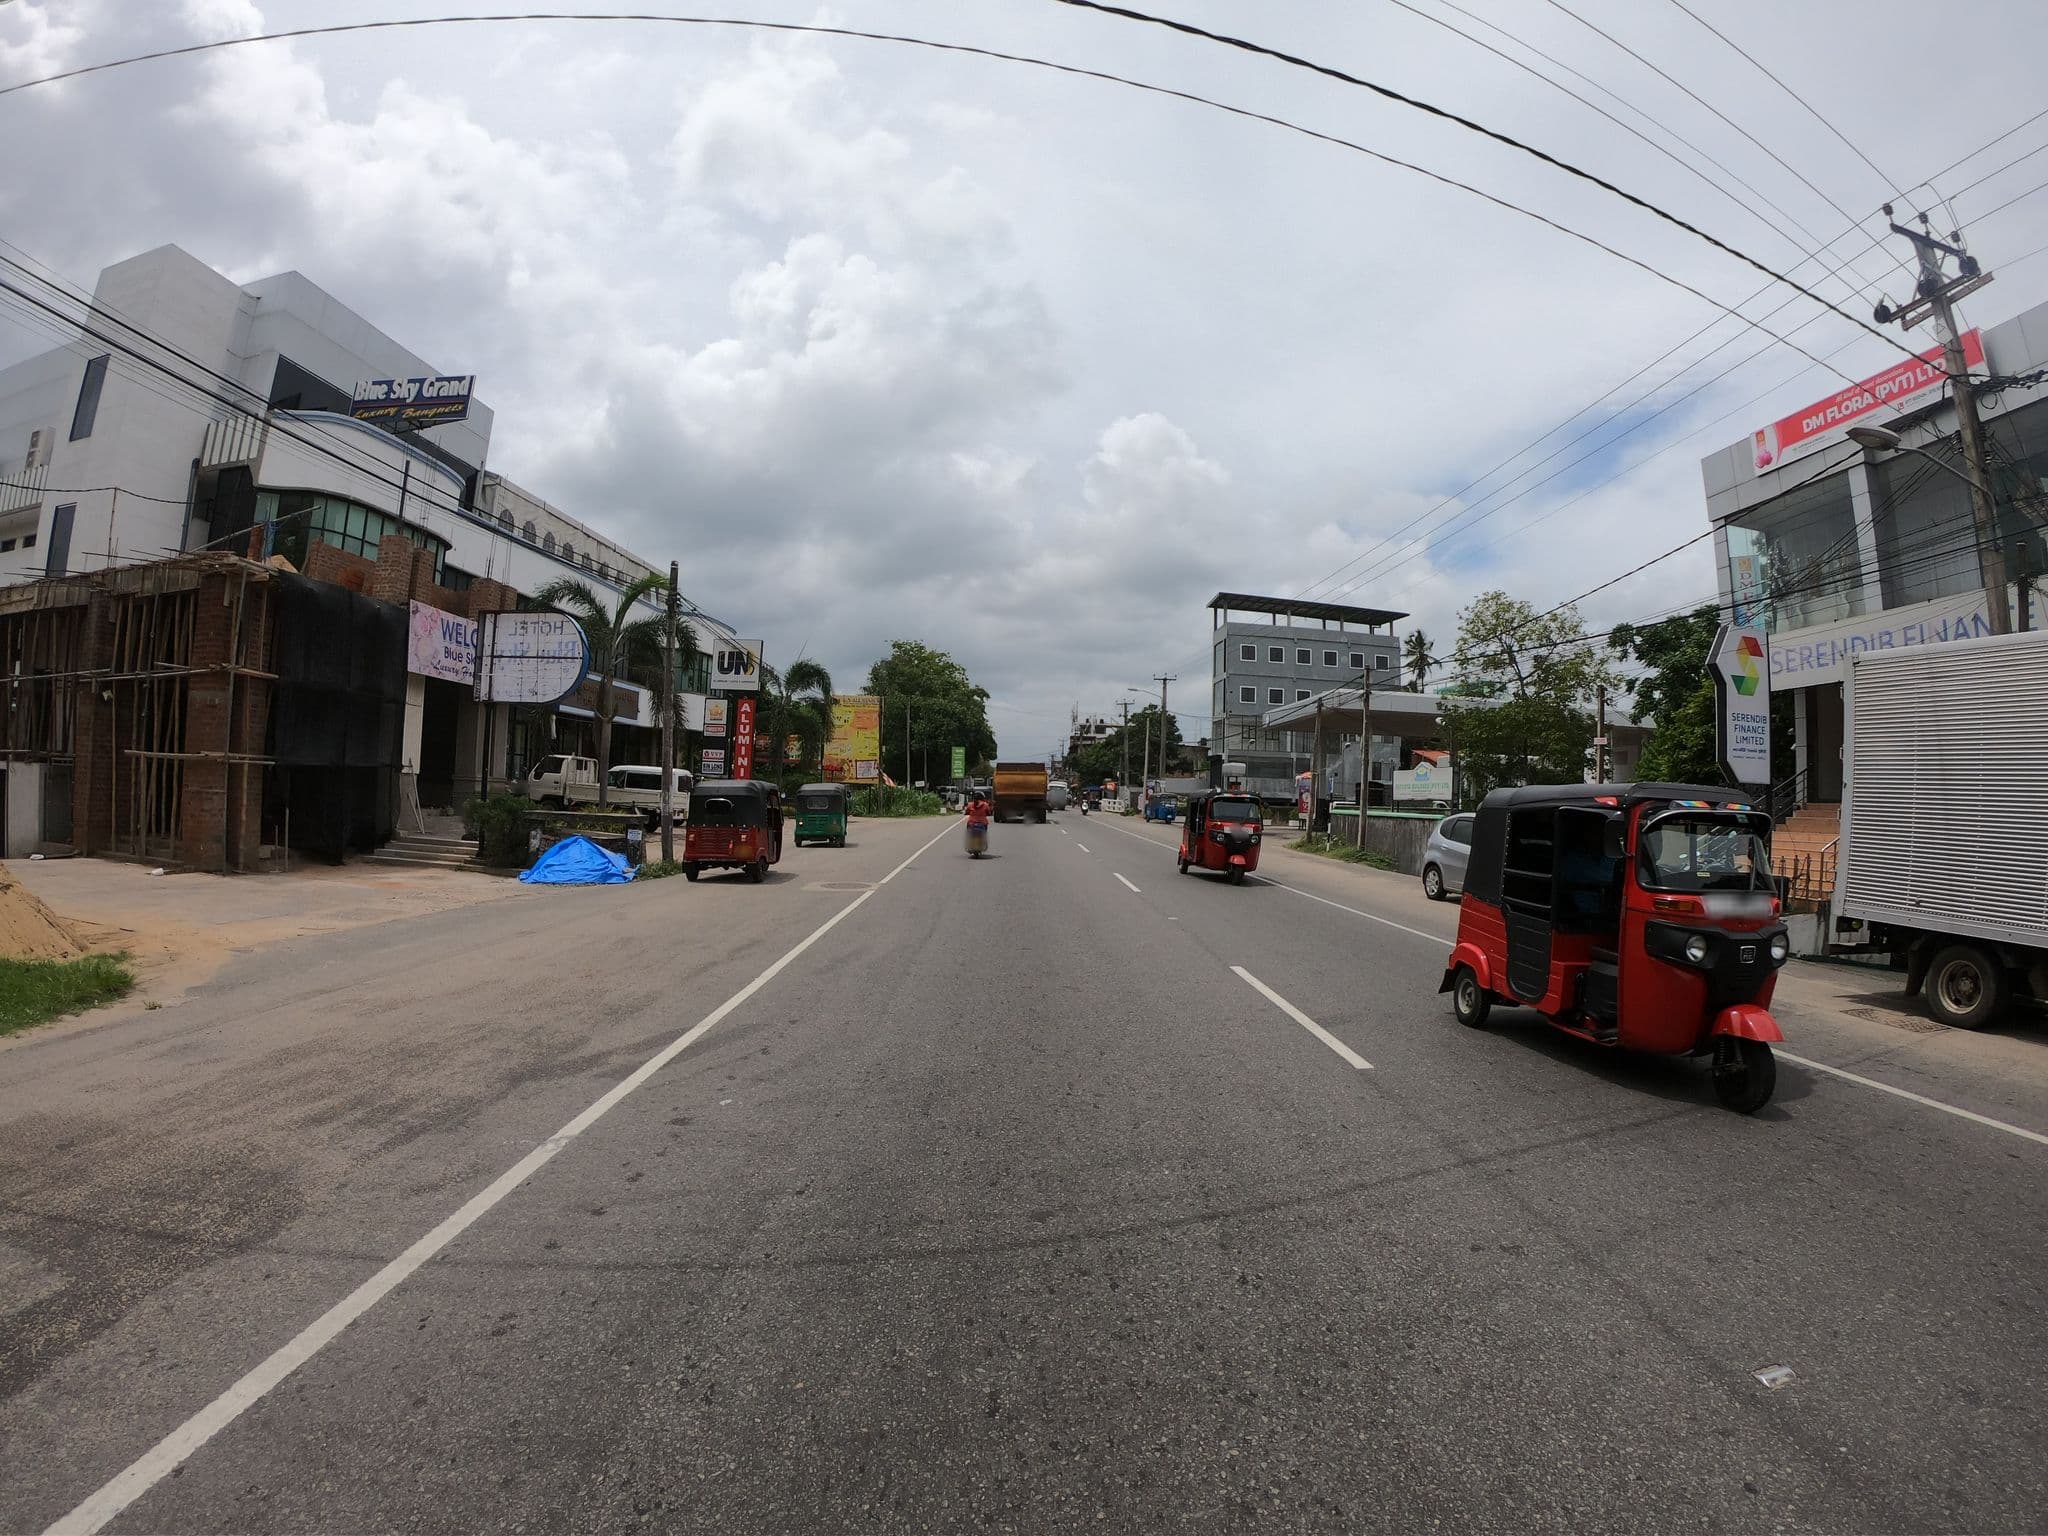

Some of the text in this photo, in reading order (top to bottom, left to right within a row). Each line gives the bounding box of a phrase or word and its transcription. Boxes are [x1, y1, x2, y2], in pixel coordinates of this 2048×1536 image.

[354, 376, 469, 403] Blue Sky Grand
[1802, 411, 1825, 434] DM
[1826, 391, 1875, 422] FLORA
[1875, 371, 1915, 400] (PVT)
[1916, 357, 1948, 383] LTD
[353, 403, 464, 419] Luxury Banquets
[444, 646, 464, 663] Blue
[1770, 629, 1894, 674] SERENDIB
[1731, 712, 1767, 725] SERENDIB
[1734, 724, 1766, 735] FINANCE
[1735, 735, 1765, 746] LIMITED
